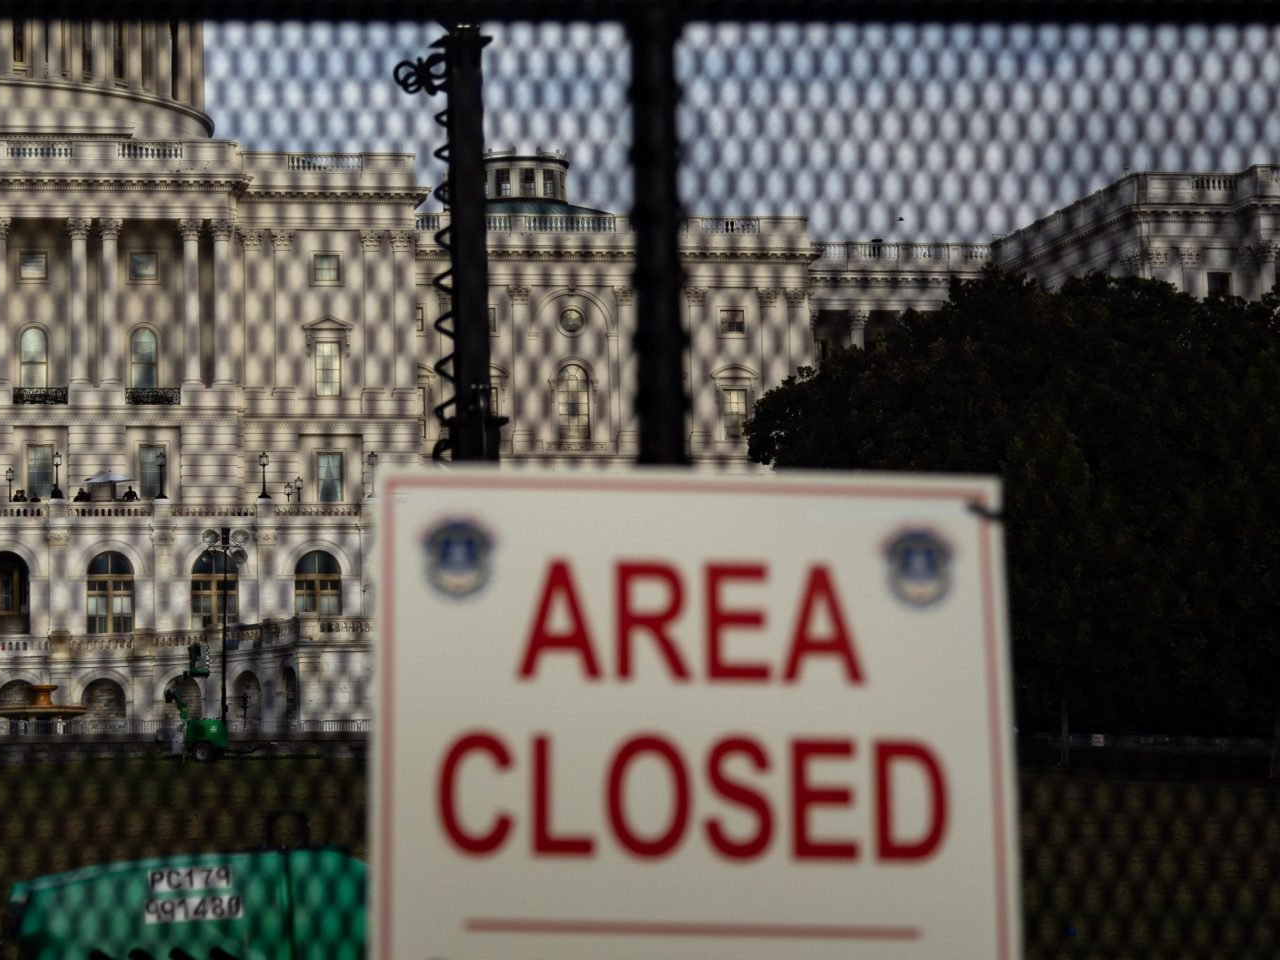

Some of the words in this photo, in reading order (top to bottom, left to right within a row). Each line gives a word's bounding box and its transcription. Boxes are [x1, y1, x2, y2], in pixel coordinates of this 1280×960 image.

[517, 557, 867, 685] AREA
[436, 729, 950, 863] CLOSED
[150, 865, 231, 890] PC179
